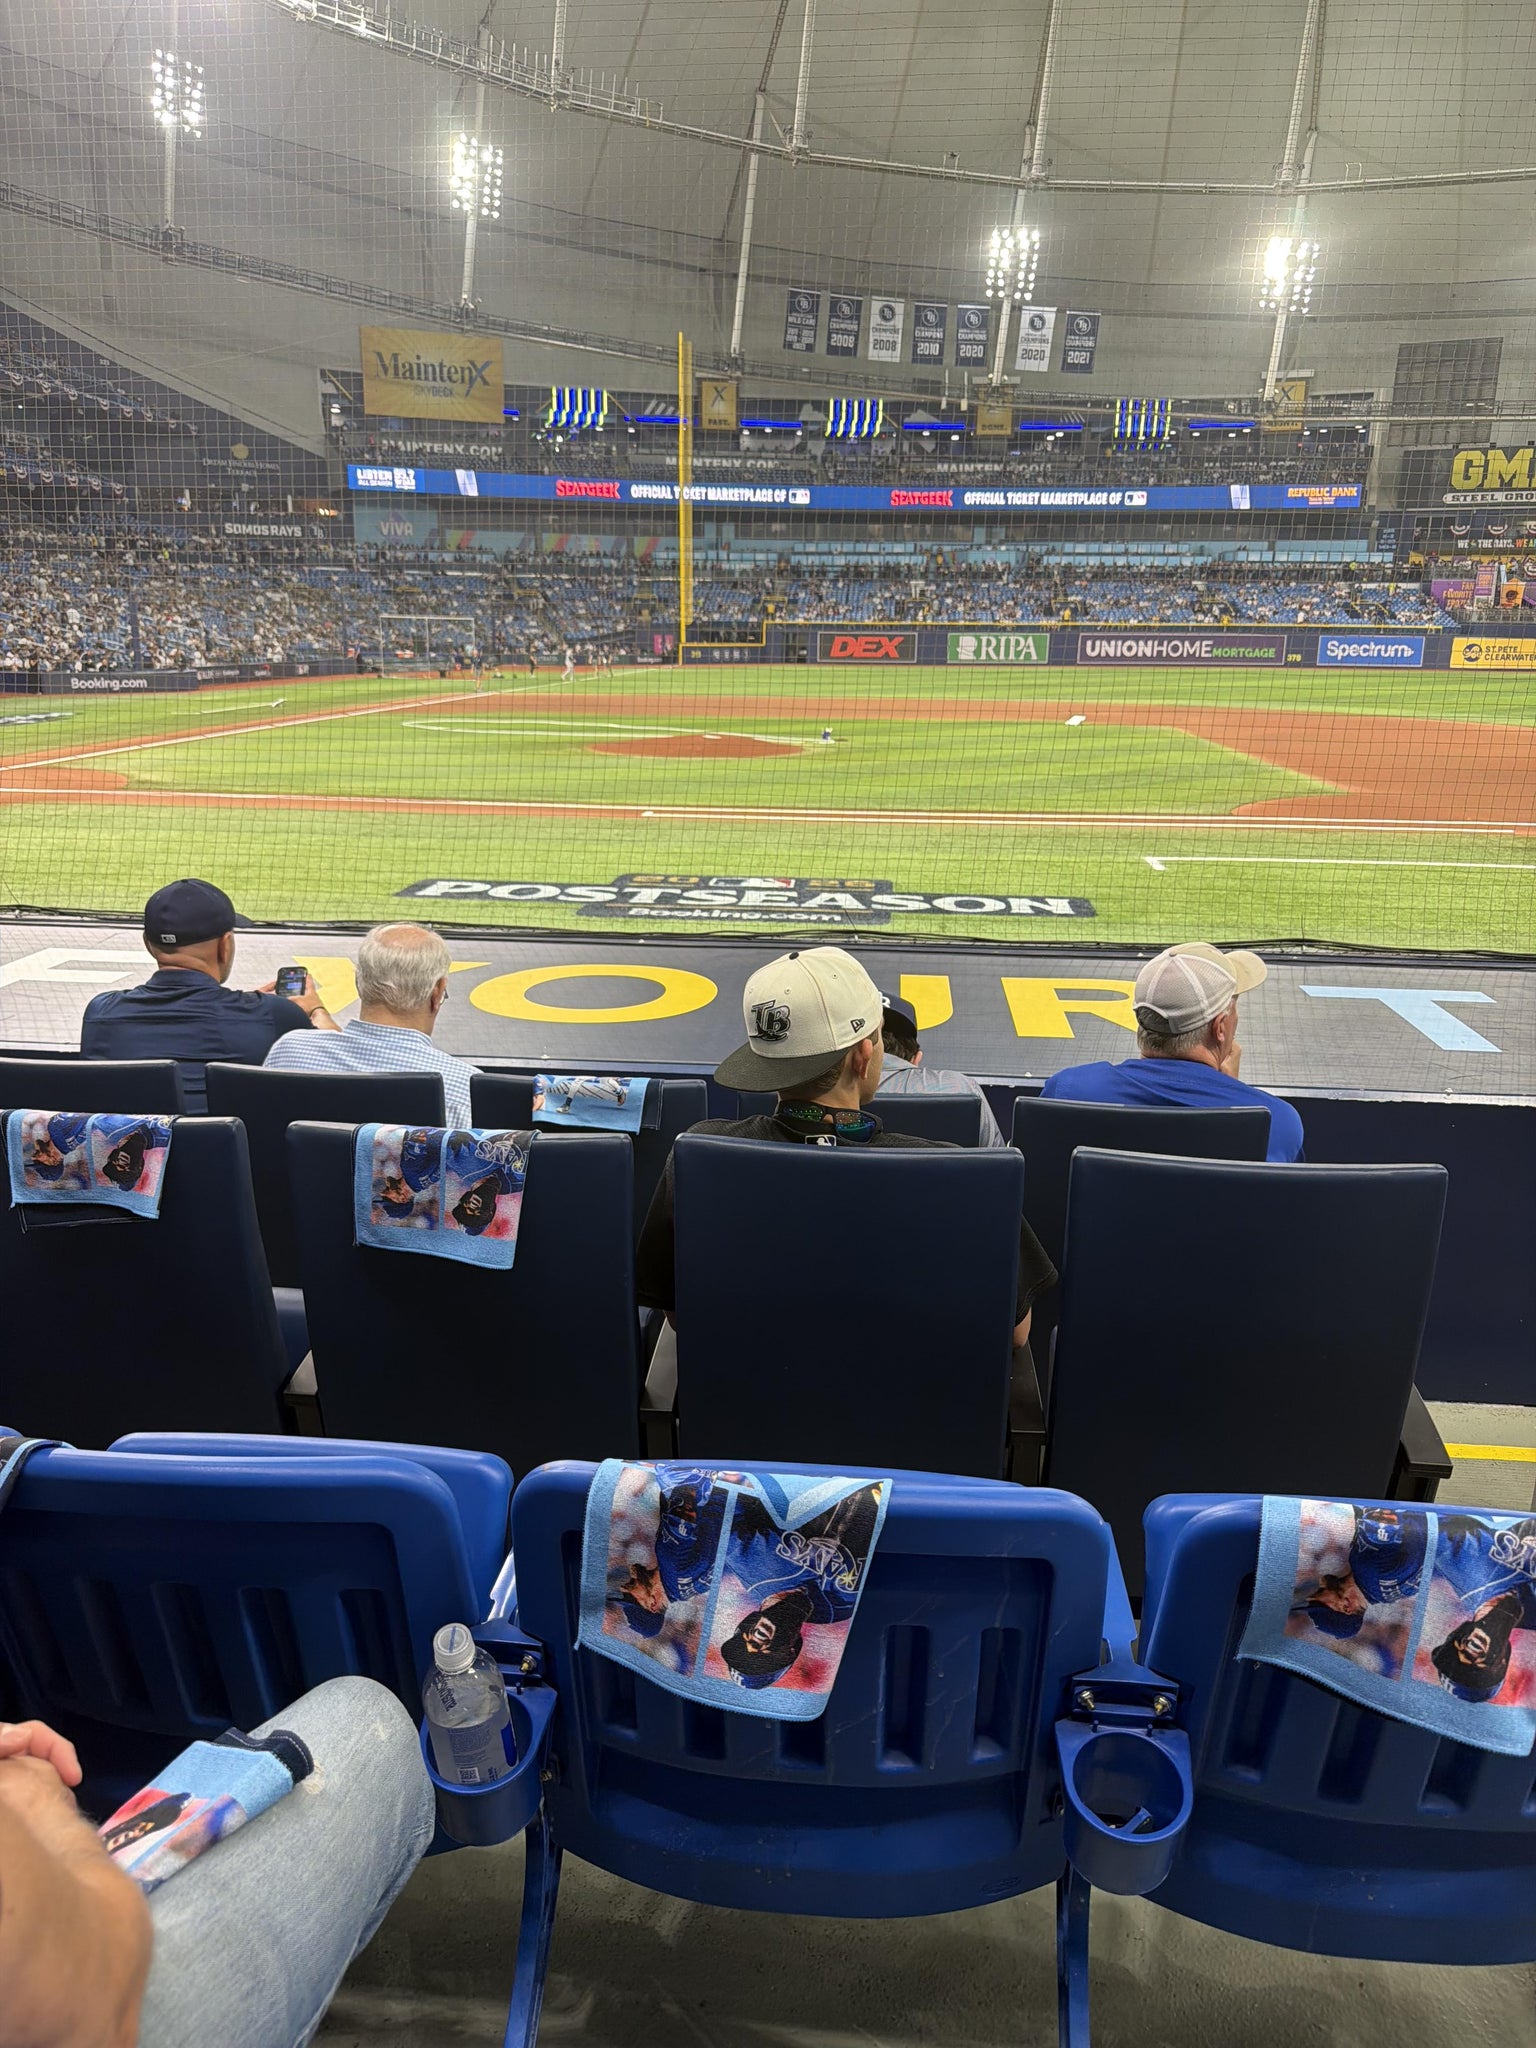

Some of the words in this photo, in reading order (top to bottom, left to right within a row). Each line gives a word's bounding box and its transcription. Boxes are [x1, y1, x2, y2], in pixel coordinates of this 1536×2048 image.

[831, 334, 855, 347] 2008
[873, 338, 896, 351] 2008
[917, 342, 940, 355] 2010
[959, 345, 984, 357] 2020
[1021, 348, 1045, 361] 2020
[1067, 351, 1090, 364] 2021
[374, 350, 492, 397] MaintenX
[1451, 448, 1536, 490] GM
[555, 478, 621, 499] SEATGEEK
[630, 484, 673, 499] OFFICIAL
[674, 486, 707, 500] TCKET
[707, 487, 773, 502] MARKETPLACE
[774, 488, 787, 502] OF
[1287, 487, 1330, 498] REPUBLIC
[1331, 486, 1358, 497] BANK
[1451, 493, 1498, 502] STEEL
[1504, 491, 1536, 501] GRO
[890, 489, 953, 507] SEATGEEK
[963, 491, 1006, 505] OFFICIAL
[1007, 491, 1038, 505] TICKET
[1041, 491, 1108, 506] MARKETPLACE
[1109, 492, 1122, 505] OF
[224, 523, 270, 536] SOMOS
[270, 525, 302, 538] RAYS
[379, 521, 414, 537] VIVA
[1478, 539, 1493, 548] THE
[1461, 581, 1475, 590] FAN
[830, 636, 904, 658] DEX
[976, 636, 1038, 660] RIPA
[1327, 640, 1409, 660] Spectrum
[71, 677, 148, 690] Booking.com
[415, 880, 1076, 915] POSTSEASON
[627, 907, 842, 922] Booking.com
